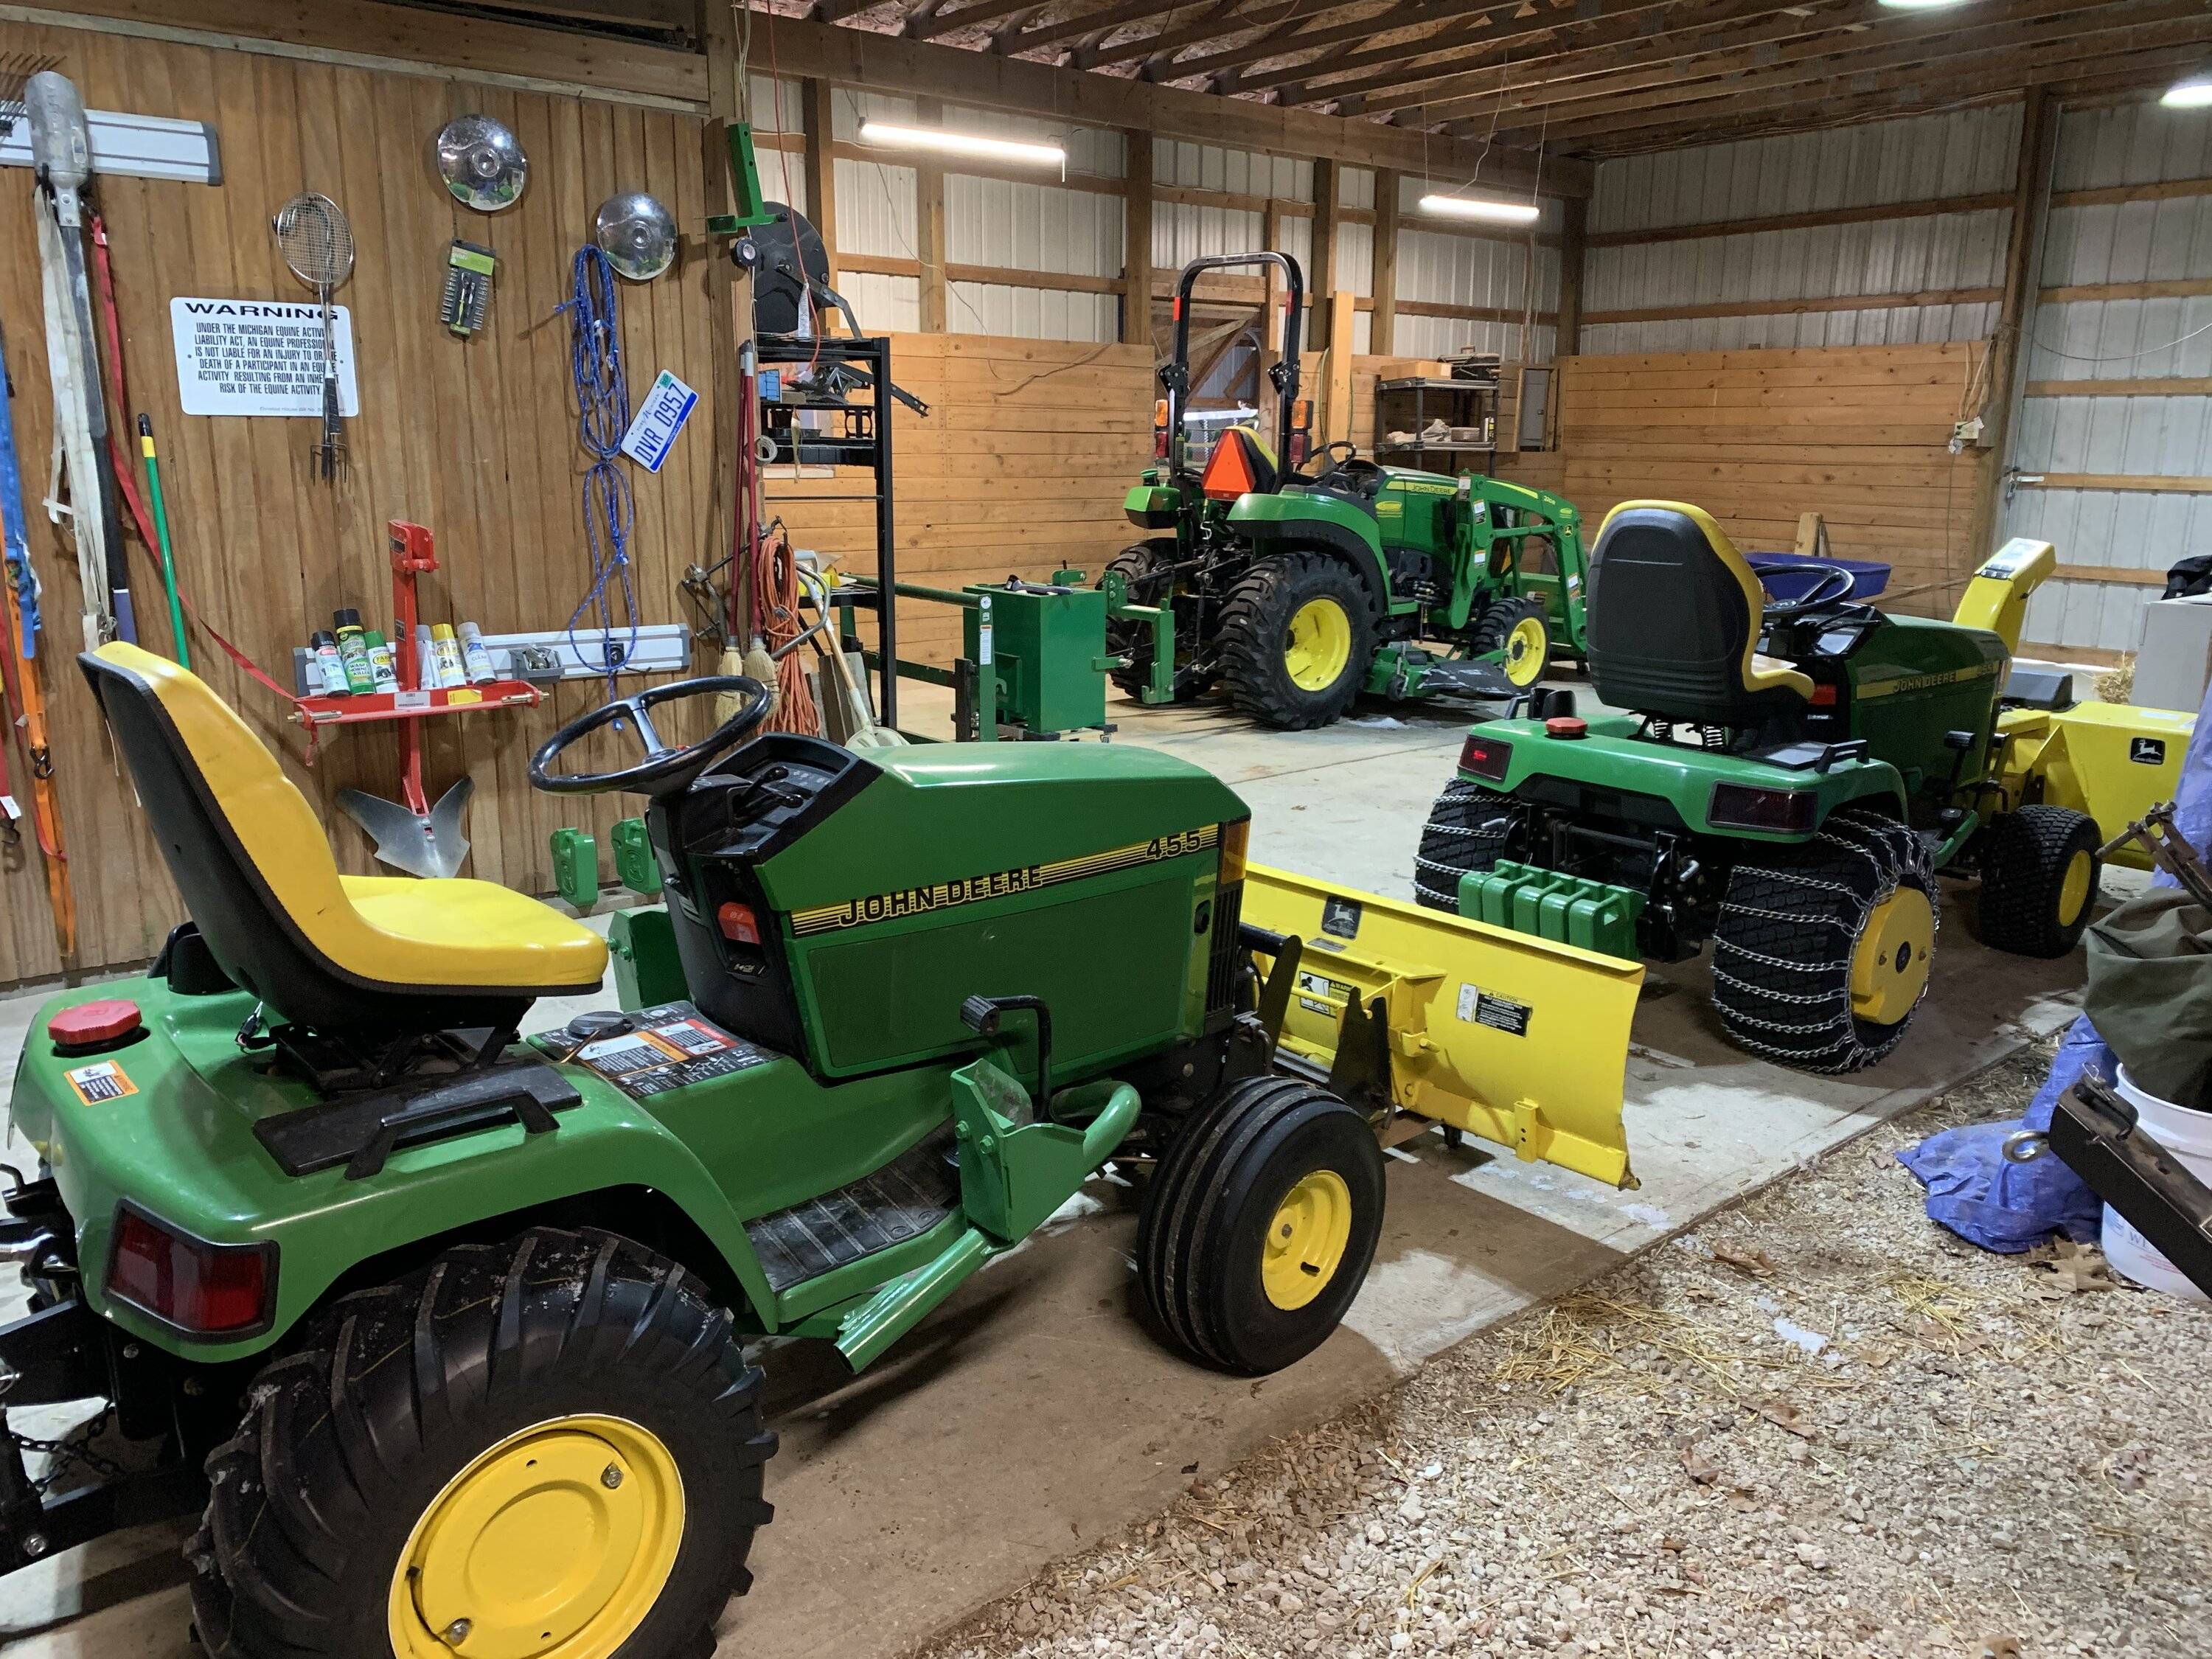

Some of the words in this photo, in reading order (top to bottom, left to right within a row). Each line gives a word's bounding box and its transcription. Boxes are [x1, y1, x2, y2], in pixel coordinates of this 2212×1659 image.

[184, 302, 338, 320] WARNING
[196, 322, 220, 333] UNDER
[223, 323, 236, 334] THE
[238, 324, 274, 335] MICHIGAN
[276, 326, 299, 337] EQUINE
[195, 334, 226, 345] LIABILITY
[229, 335, 245, 347] ACT,
[248, 337, 257, 347] AN
[260, 337, 285, 348] EQUINE
[195, 346, 202, 356] IS
[205, 347, 219, 357] NOT
[222, 347, 245, 358] LIABLE
[248, 348, 260, 358] FOR
[262, 349, 273, 359] AN
[275, 349, 300, 360] INJURY
[303, 350, 311, 361] TO
[313, 351, 323, 361] OR
[199, 358, 221, 369] DEATH
[224, 359, 232, 369] OF
[235, 360, 240, 369] A
[243, 360, 287, 371] PARTICIPANT
[290, 361, 298, 372] IN
[300, 362, 310, 372] AN
[198, 370, 229, 381] ACTIVITY
[234, 371, 271, 382] RESULTING
[273, 372, 293, 383] FROM
[295, 373, 305, 383] AN
[219, 383, 236, 393] RISK
[238, 383, 246, 393] OF
[248, 383, 262, 394] THE
[264, 383, 288, 394] EQUINE
[634, 428, 664, 463] DVR
[653, 383, 686, 427] 0957
[1893, 677, 1924, 693] JOHN
[1924, 672, 1957, 688] DEERE
[1144, 829, 1202, 860] 455
[838, 884, 936, 927] JOHN
[947, 864, 1043, 906] DEERE
